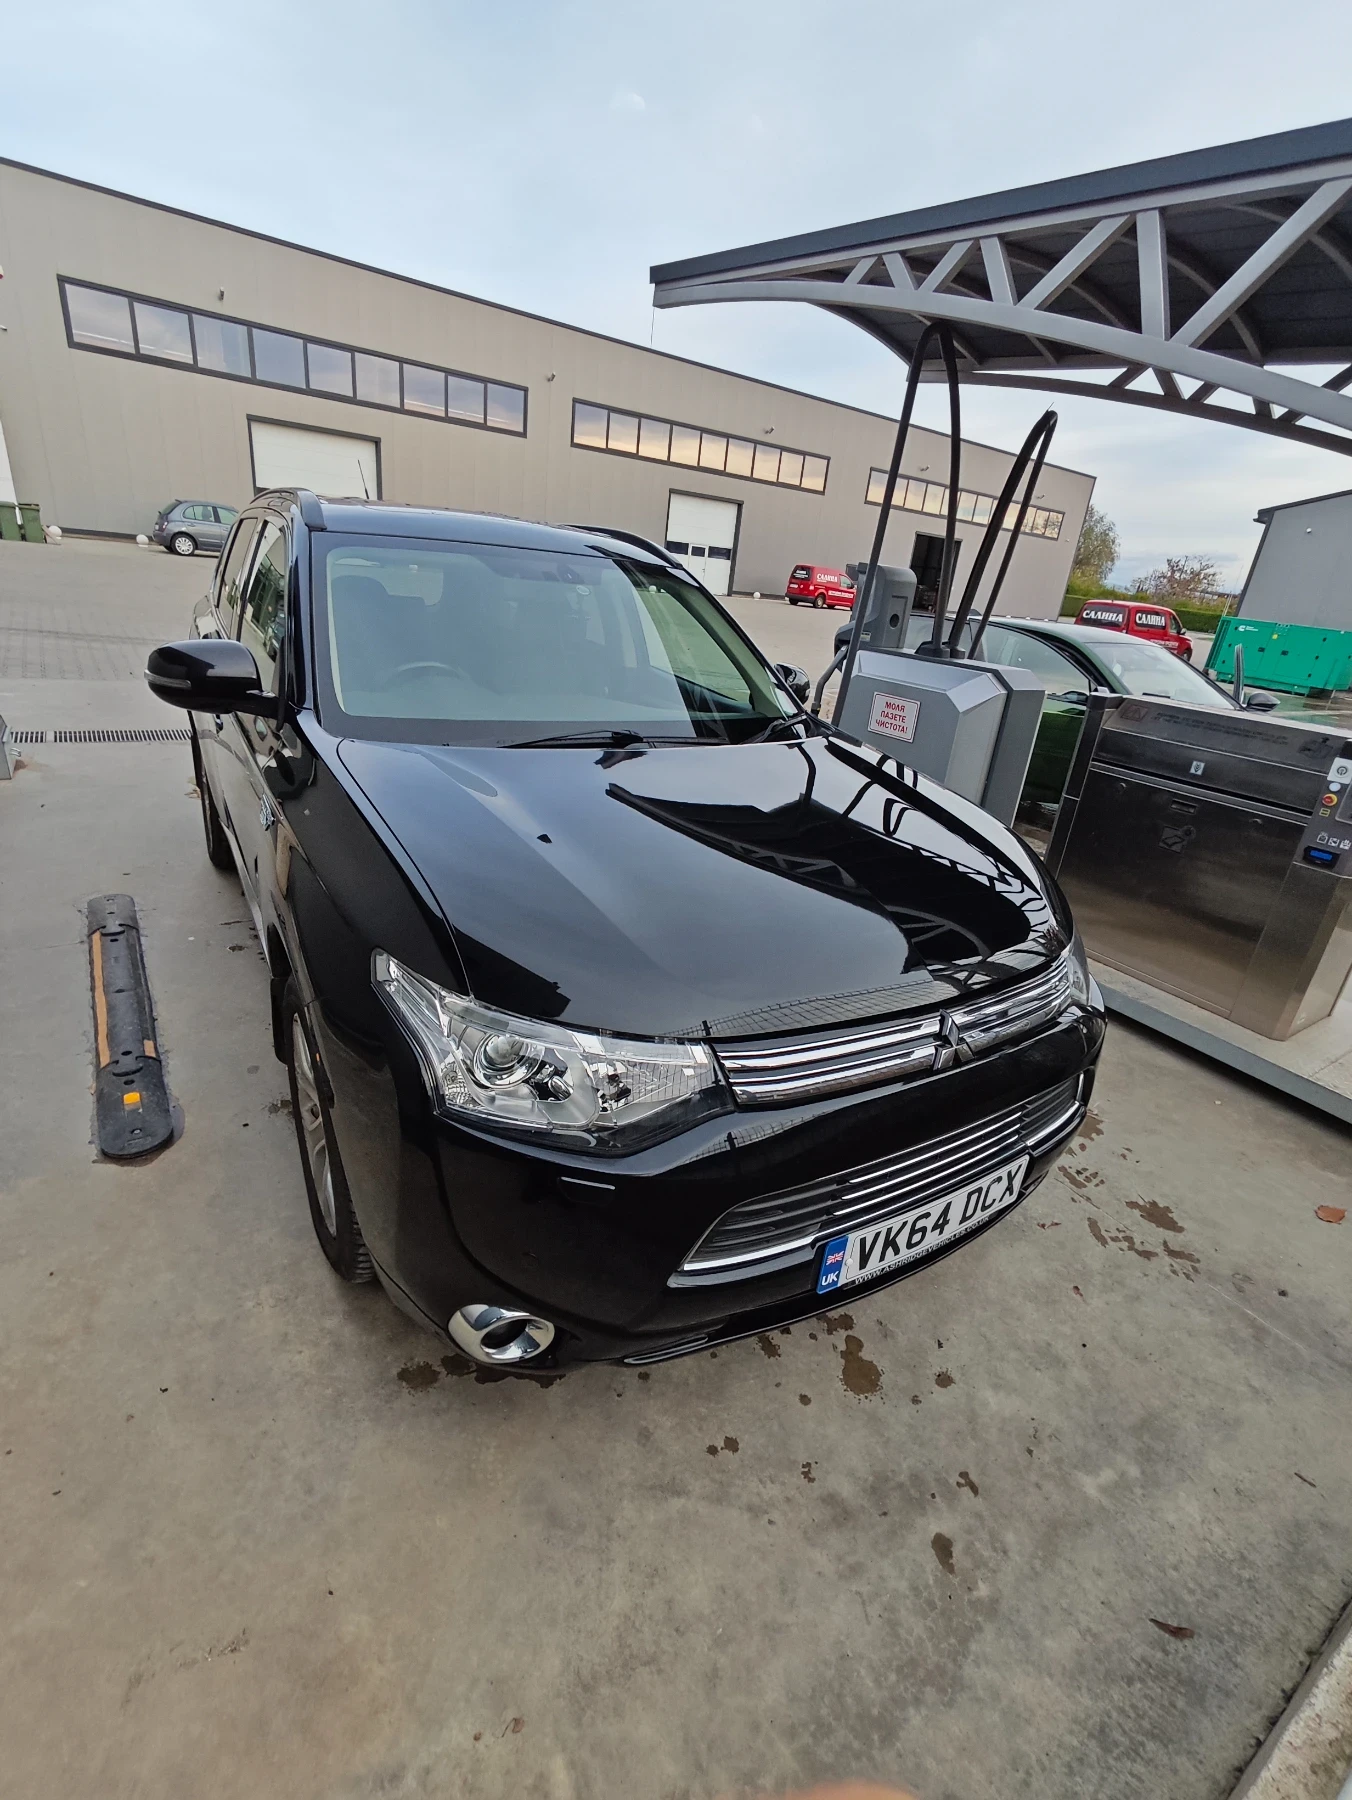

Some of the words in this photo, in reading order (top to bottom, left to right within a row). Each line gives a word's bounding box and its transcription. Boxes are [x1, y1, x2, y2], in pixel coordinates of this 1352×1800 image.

[1083, 610, 1123, 622] САЛИНА
[1136, 613, 1165, 626] САЛИНА
[885, 701, 905, 712] МОЛЯ
[881, 711, 906, 723] ПАЗЕТЕ
[876, 719, 908, 733] ЧИСТОТА!
[858, 1200, 953, 1271] VK64
[959, 1163, 1023, 1226] DCX
[821, 1270, 840, 1287] UK
